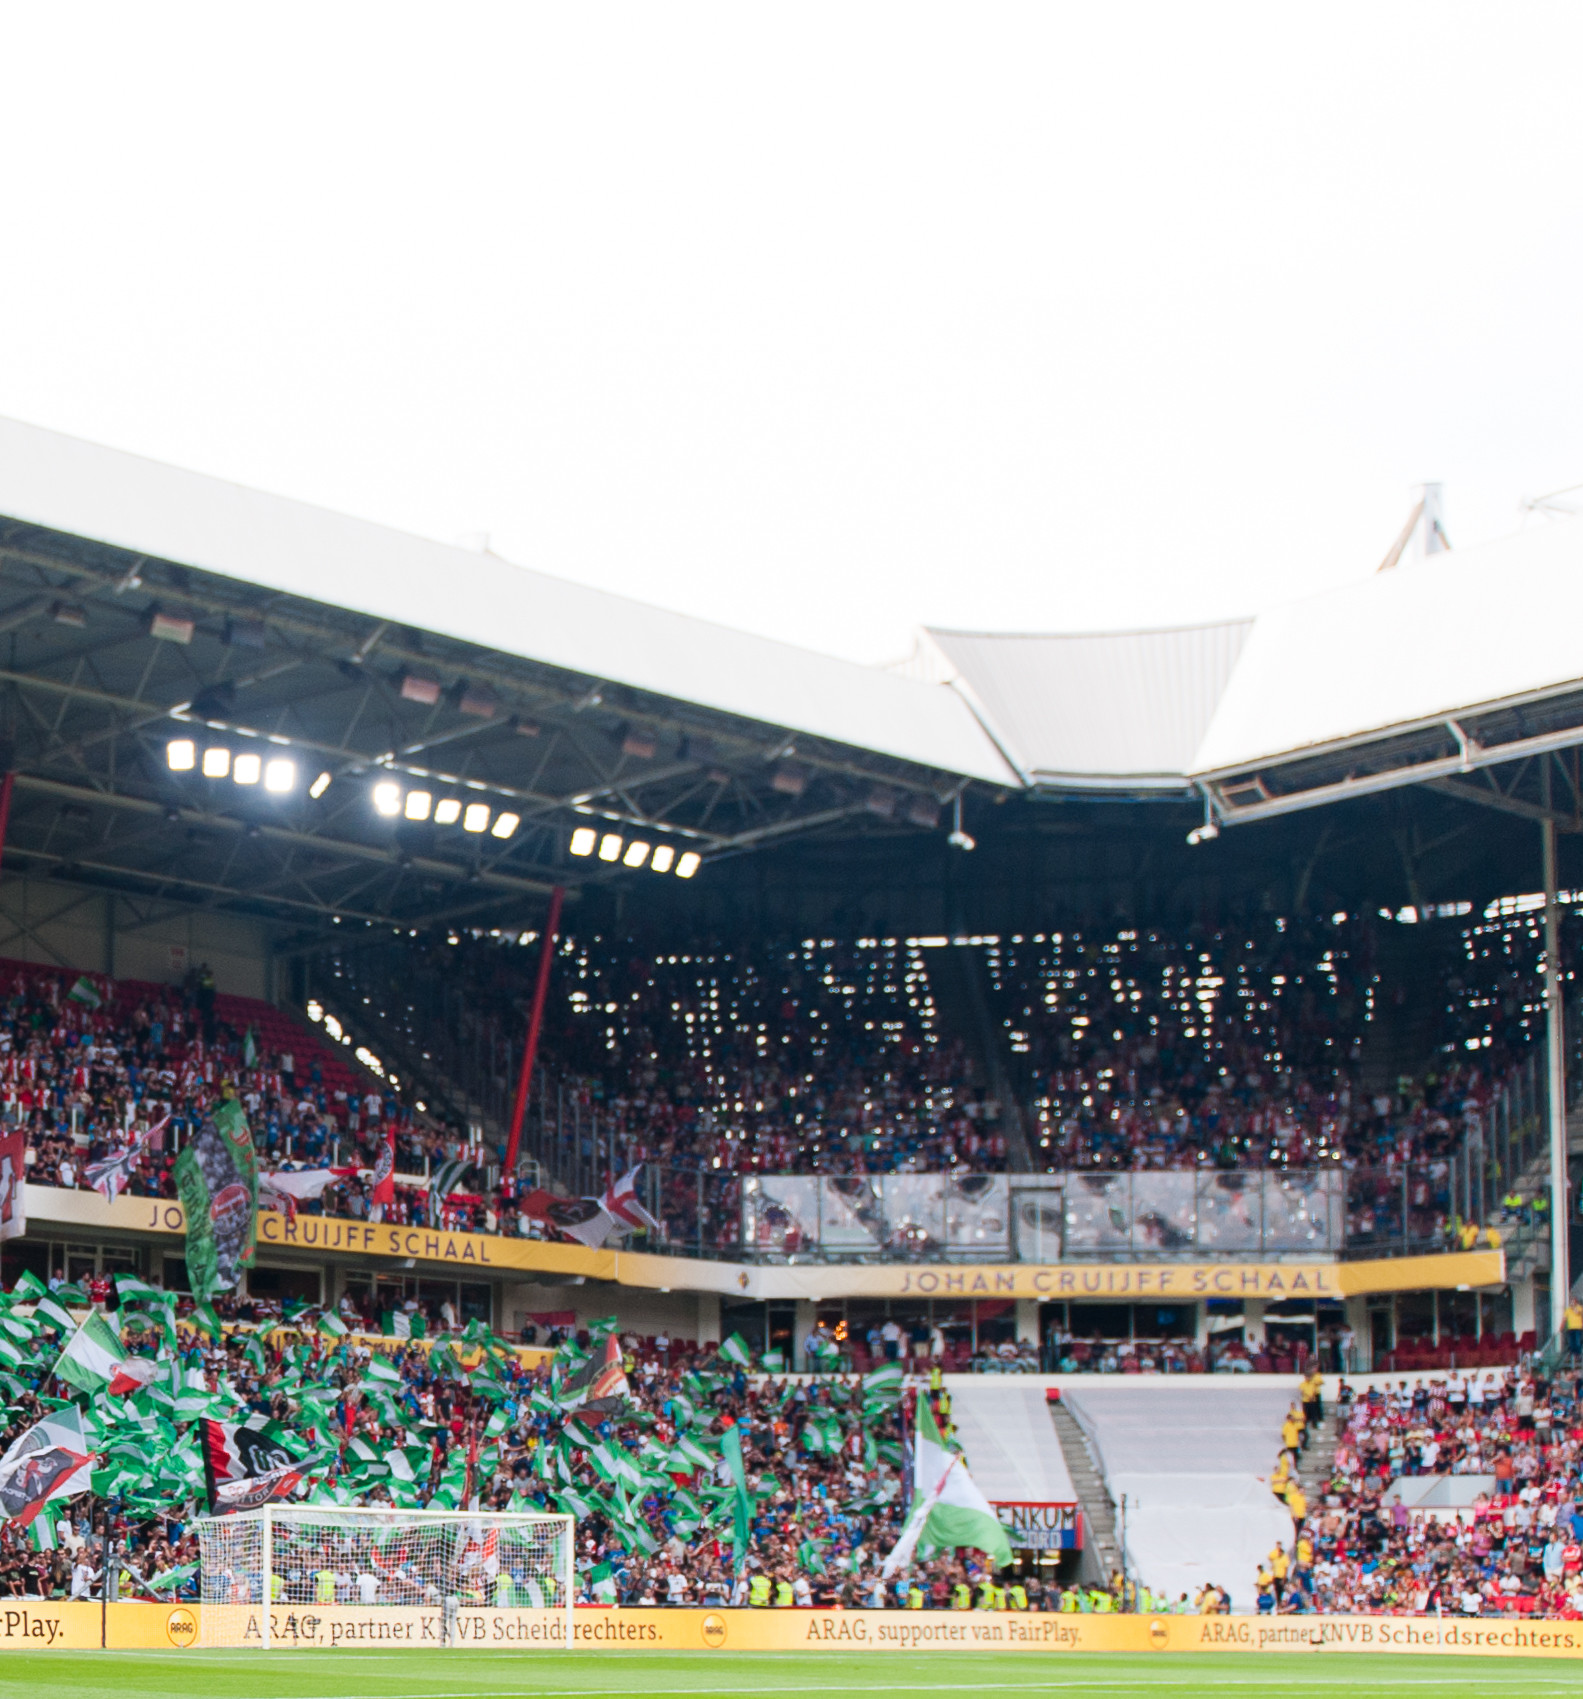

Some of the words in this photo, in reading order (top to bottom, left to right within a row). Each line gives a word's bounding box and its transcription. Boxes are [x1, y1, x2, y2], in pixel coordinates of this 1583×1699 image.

[263, 1218, 375, 1250] CRUIJFF
[389, 1231, 491, 1262] SCHAAL
[901, 1271, 1015, 1293] JOHAN
[1033, 1271, 1173, 1292] CRUIJFF
[1193, 1270, 1330, 1291] SCHAAL
[169, 1621, 193, 1634] ARAG
[330, 1618, 414, 1646] partner
[806, 1618, 872, 1645] ARAG,
[878, 1622, 967, 1647] supporter
[971, 1625, 1003, 1641] van
[1008, 1620, 1082, 1648] FairPlay.
[1201, 1623, 1254, 1645] ARAG,
[1258, 1625, 1315, 1648] partner
[1319, 1623, 1373, 1642] KNVB
[1379, 1624, 1581, 1648] Scheidsrechters.
